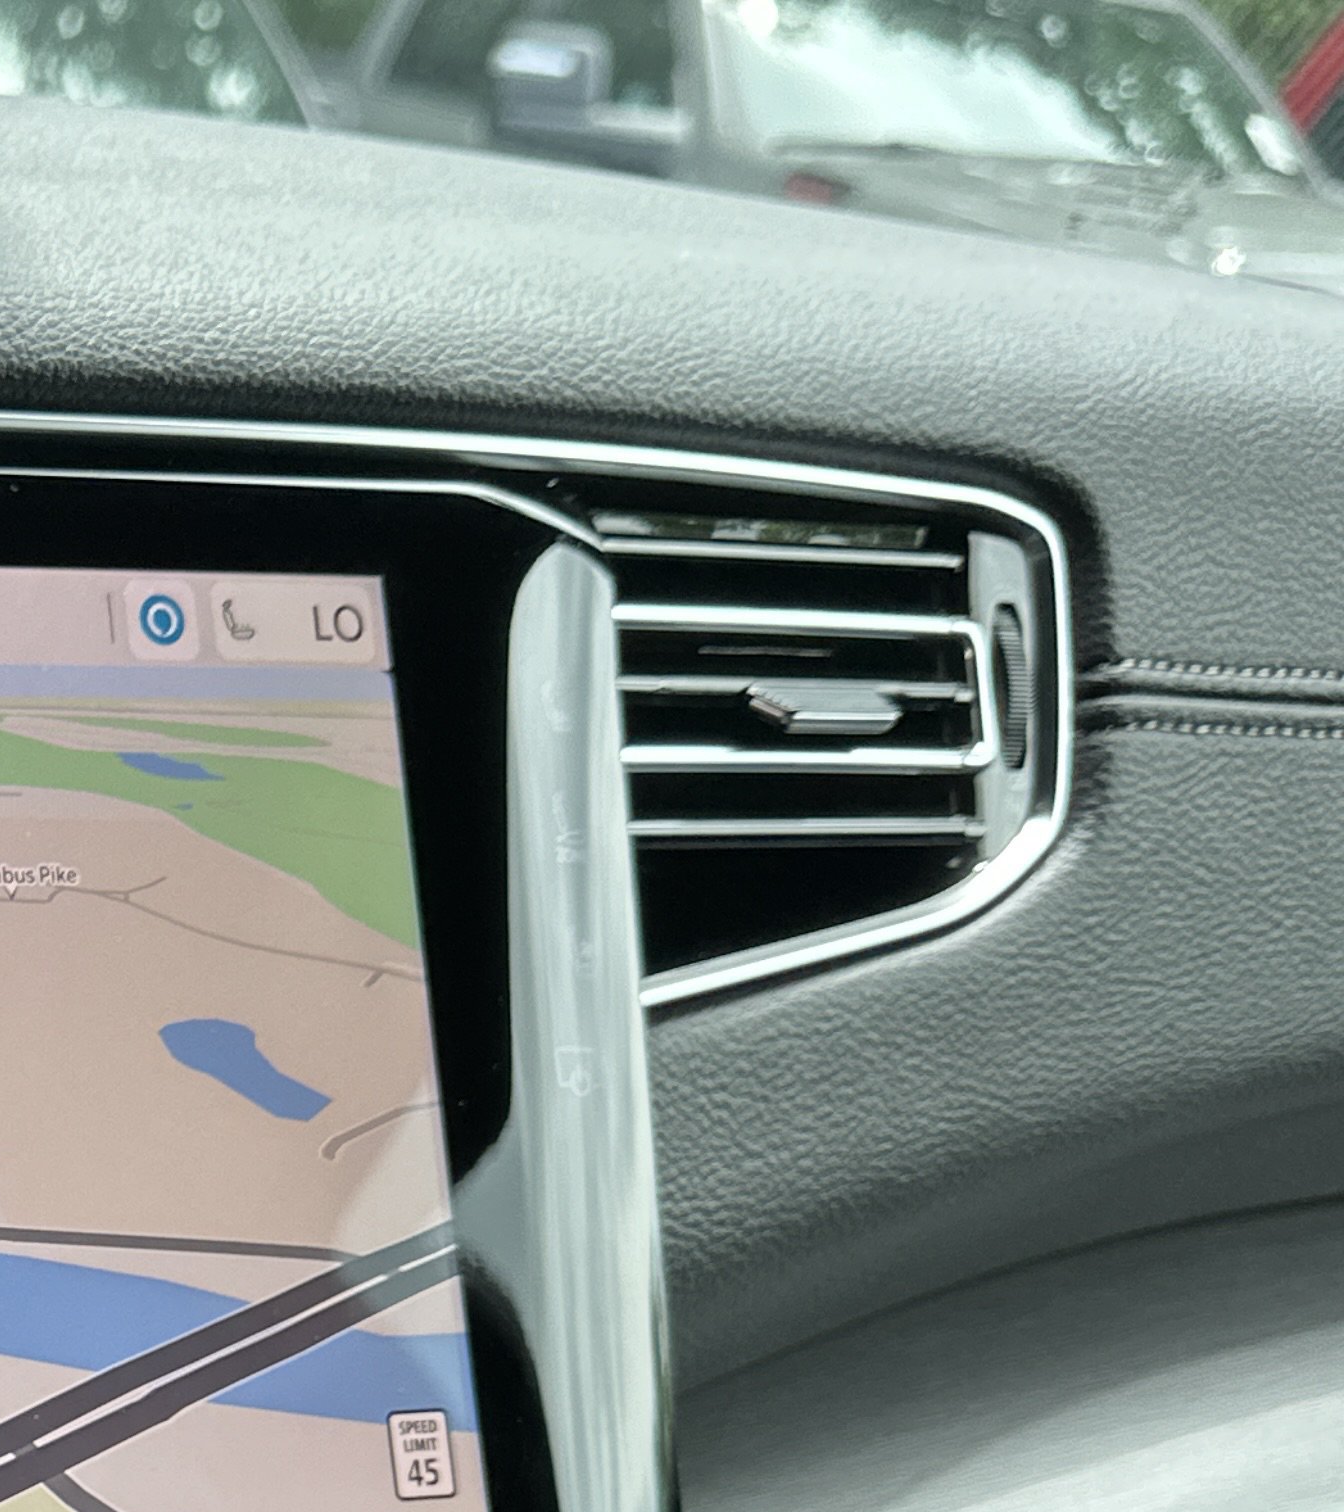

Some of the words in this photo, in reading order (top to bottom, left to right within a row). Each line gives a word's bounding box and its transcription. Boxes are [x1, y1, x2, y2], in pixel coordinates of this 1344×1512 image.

[313, 605, 364, 642] LO
[40, 865, 77, 884] Pike
[398, 1420, 437, 1435] SPEED
[403, 1437, 437, 1452] LIMIT
[408, 1458, 439, 1487] 45
